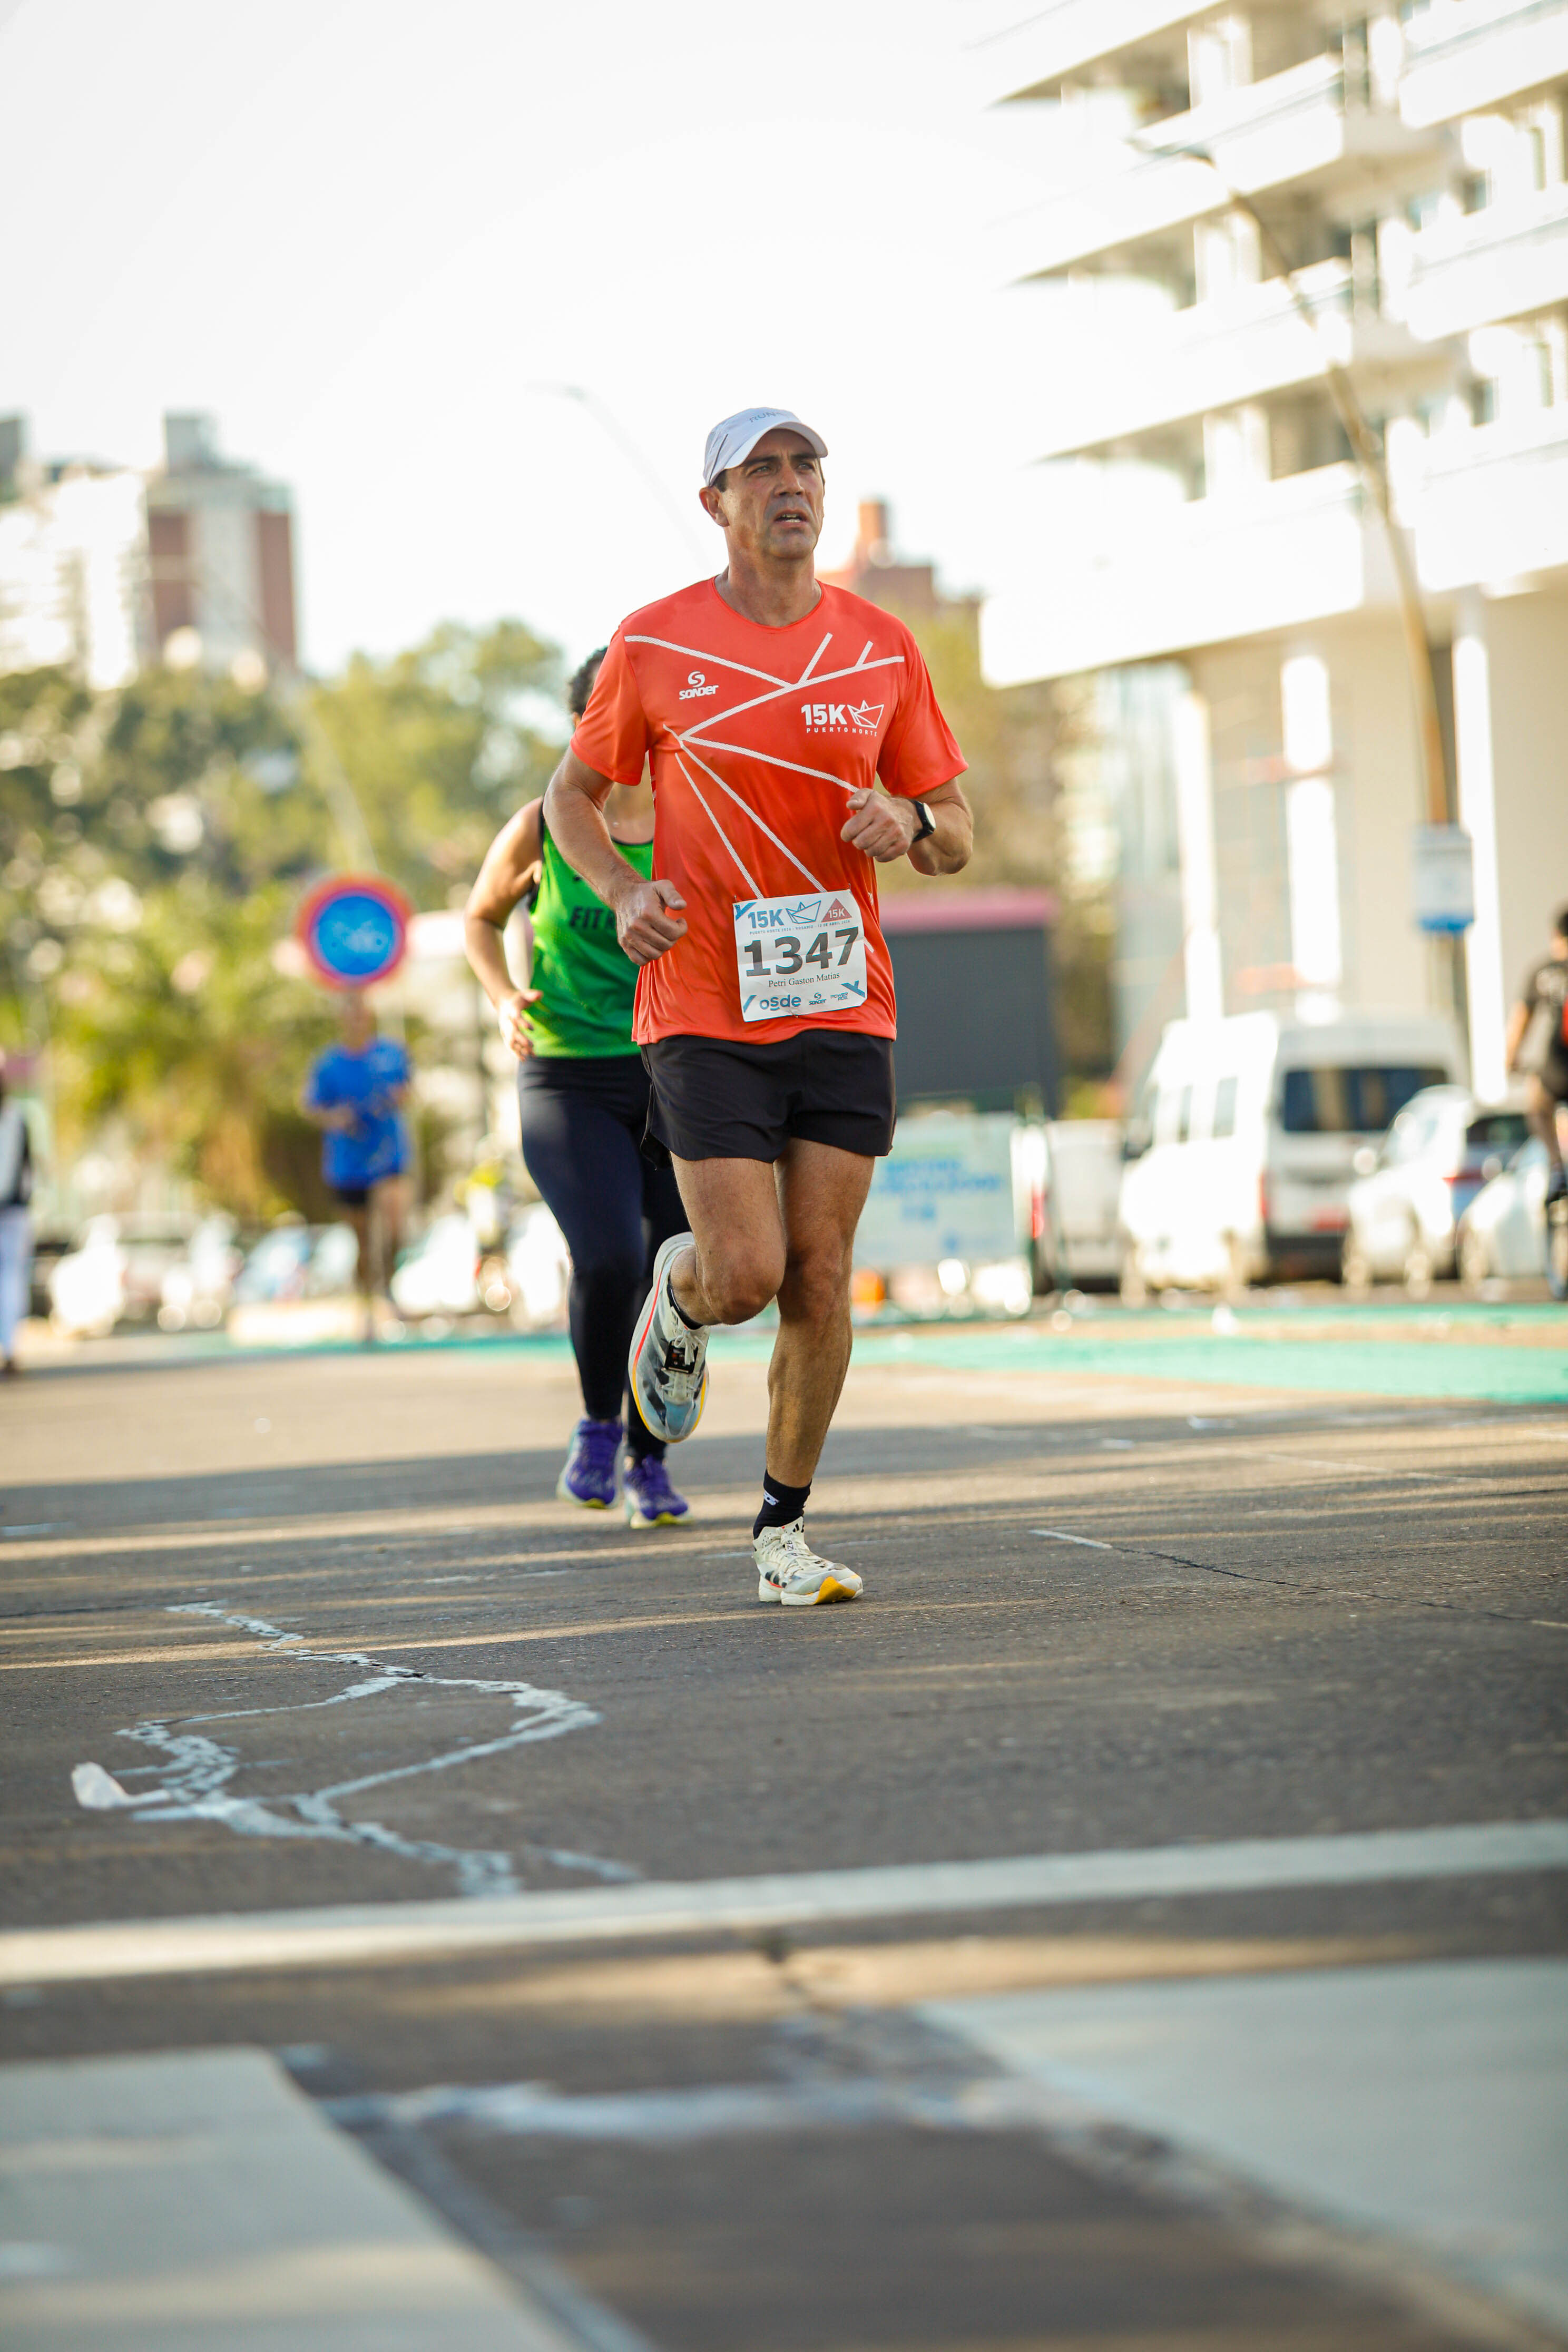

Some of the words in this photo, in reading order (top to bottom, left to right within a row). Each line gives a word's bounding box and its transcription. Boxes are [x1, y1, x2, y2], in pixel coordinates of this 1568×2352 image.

[801, 703, 848, 726] 15K
[852, 728, 877, 737] NORTE
[748, 908, 785, 929] 15K
[828, 907, 846, 919] 15K
[743, 926, 859, 977] 1347
[769, 979, 786, 987] Petri
[788, 977, 815, 985] Gaston
[816, 972, 840, 982] Matias
[759, 994, 801, 1011] osde
